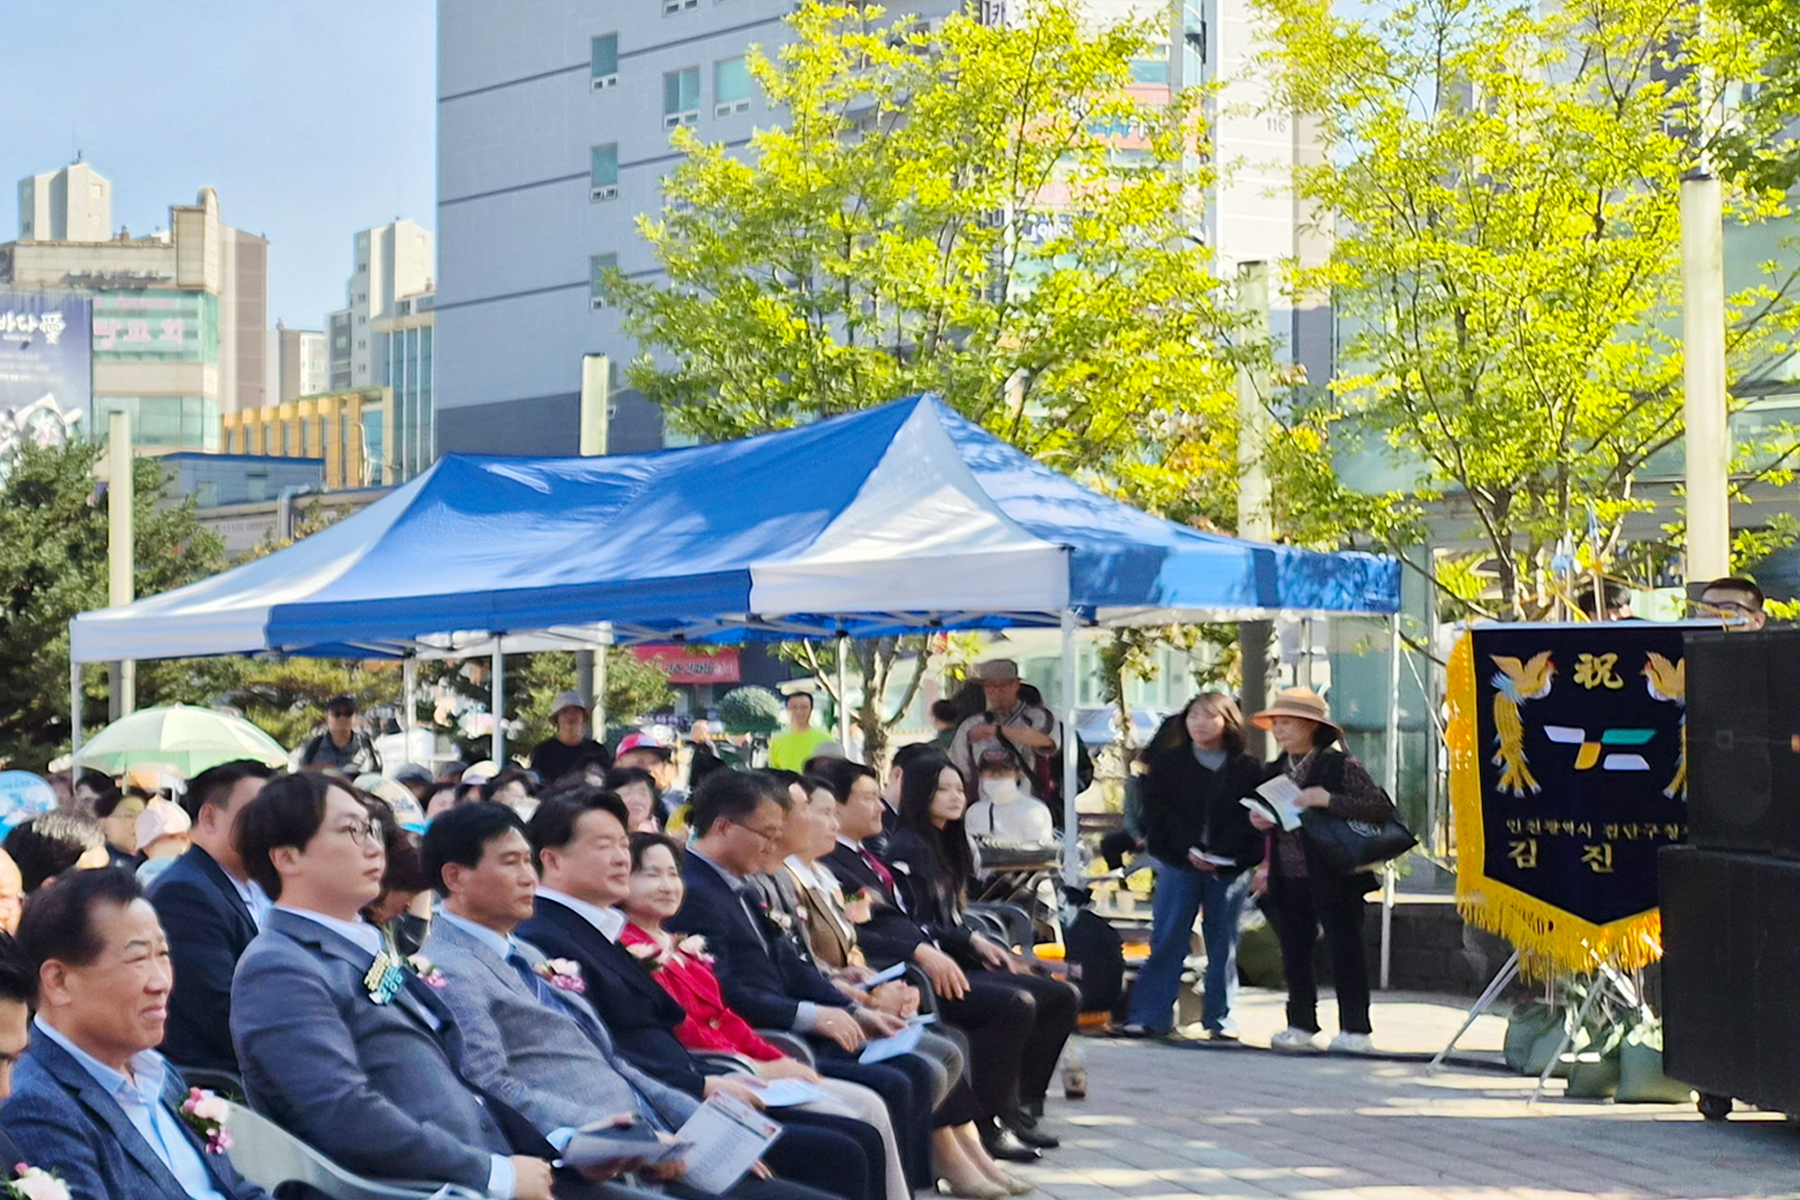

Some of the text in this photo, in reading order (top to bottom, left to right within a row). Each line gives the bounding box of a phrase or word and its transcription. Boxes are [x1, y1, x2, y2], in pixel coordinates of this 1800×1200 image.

[1266, 118, 1286, 133] 116
[1573, 652, 1624, 689] 祝
[1506, 818, 1688, 843] 인천광역시 검단구청
[1507, 839, 1614, 874] 김 진
